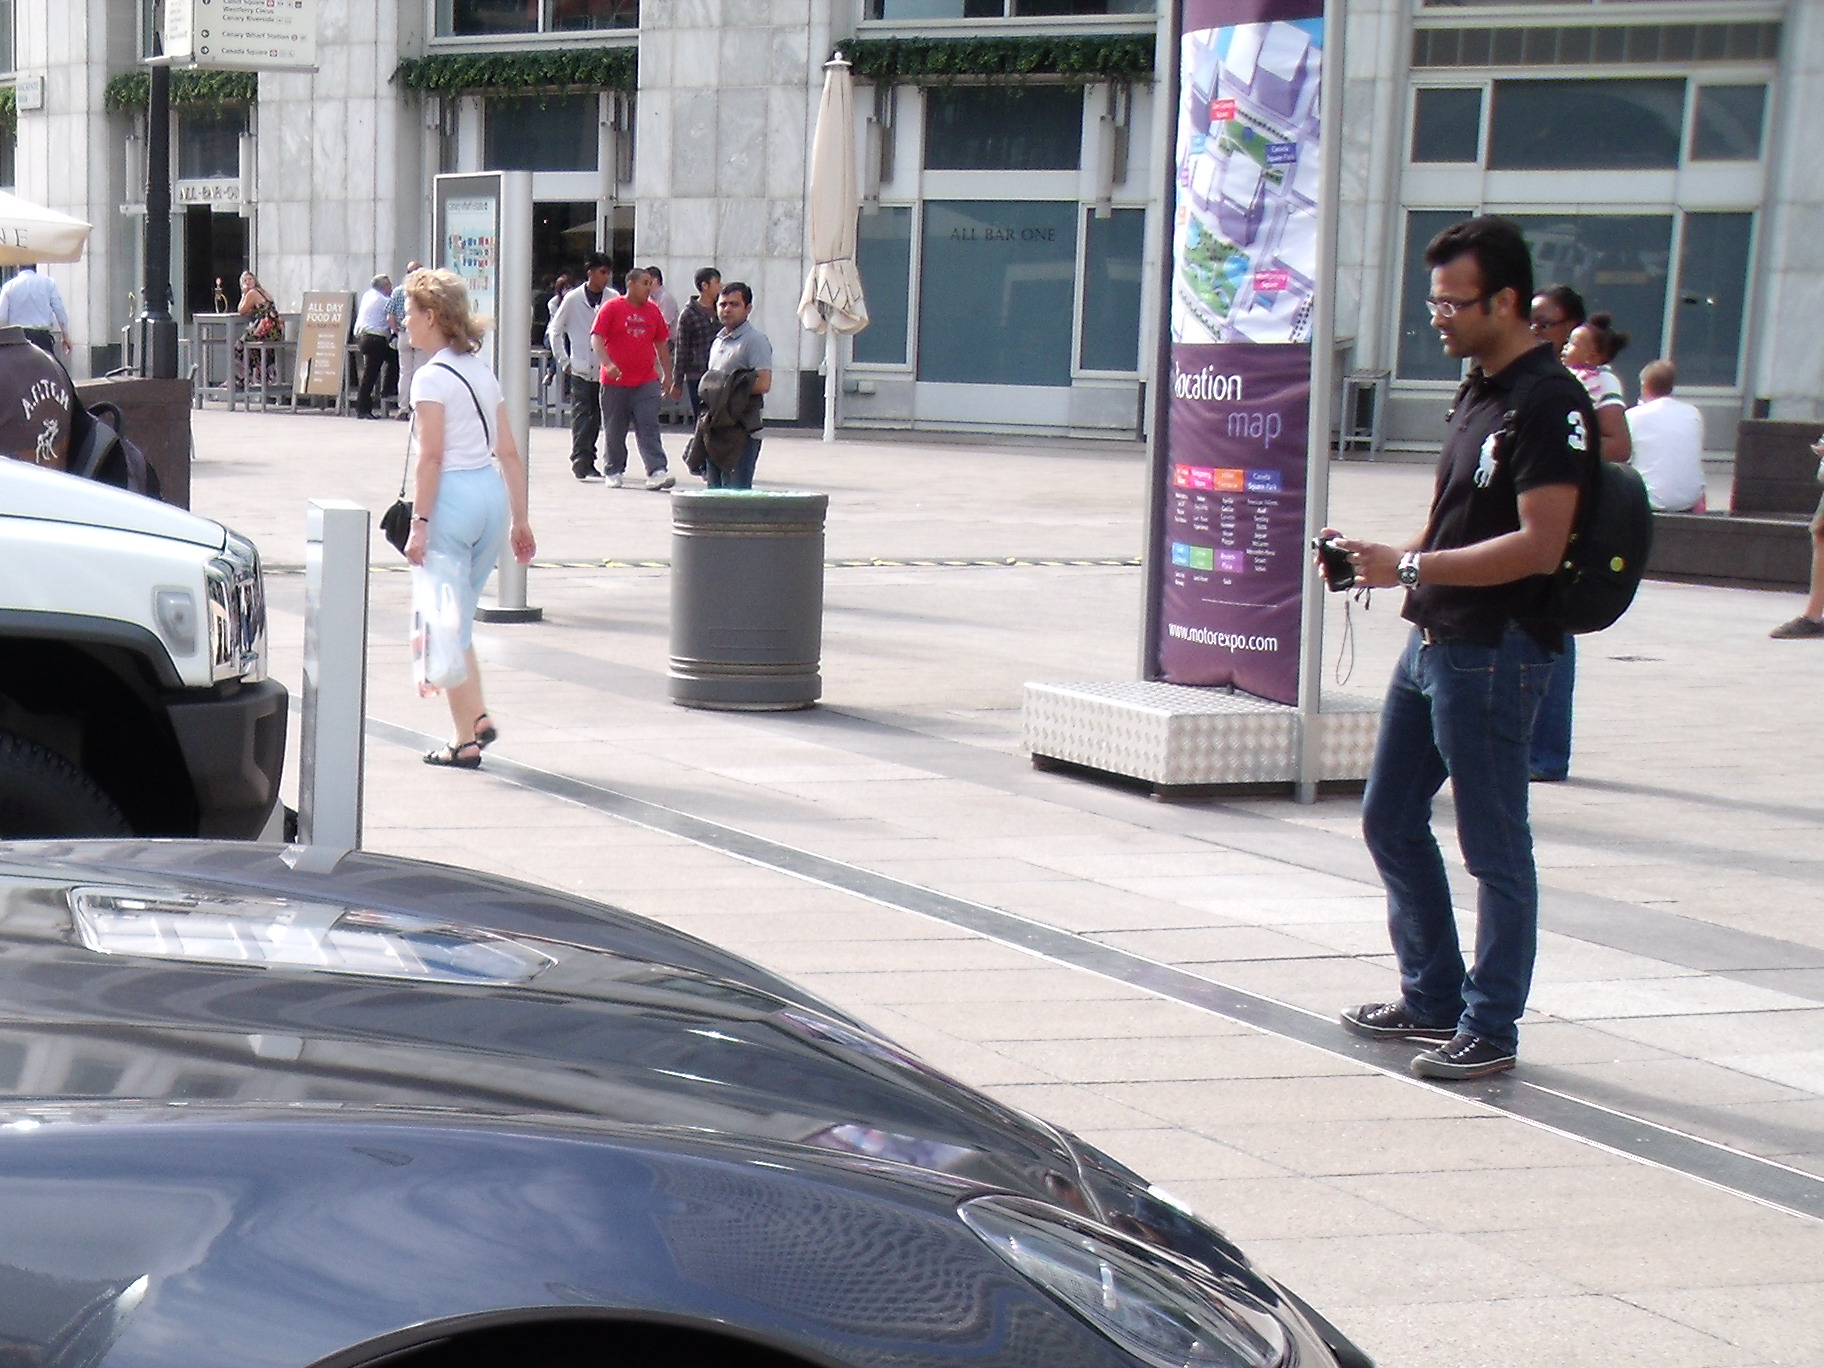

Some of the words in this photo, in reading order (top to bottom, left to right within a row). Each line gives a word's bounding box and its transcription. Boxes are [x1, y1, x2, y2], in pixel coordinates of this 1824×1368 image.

[950, 227, 976, 241] ALL
[985, 228, 1015, 241] BAR
[1021, 228, 1056, 242] ONE
[306, 312, 330, 322] FOOD
[308, 302, 323, 312] ALL
[326, 303, 344, 313] DAY
[1174, 360, 1242, 401] location
[1227, 411, 1282, 450] map
[1567, 410, 1587, 451] 3
[1168, 622, 1278, 653] www.motorexpo.com
